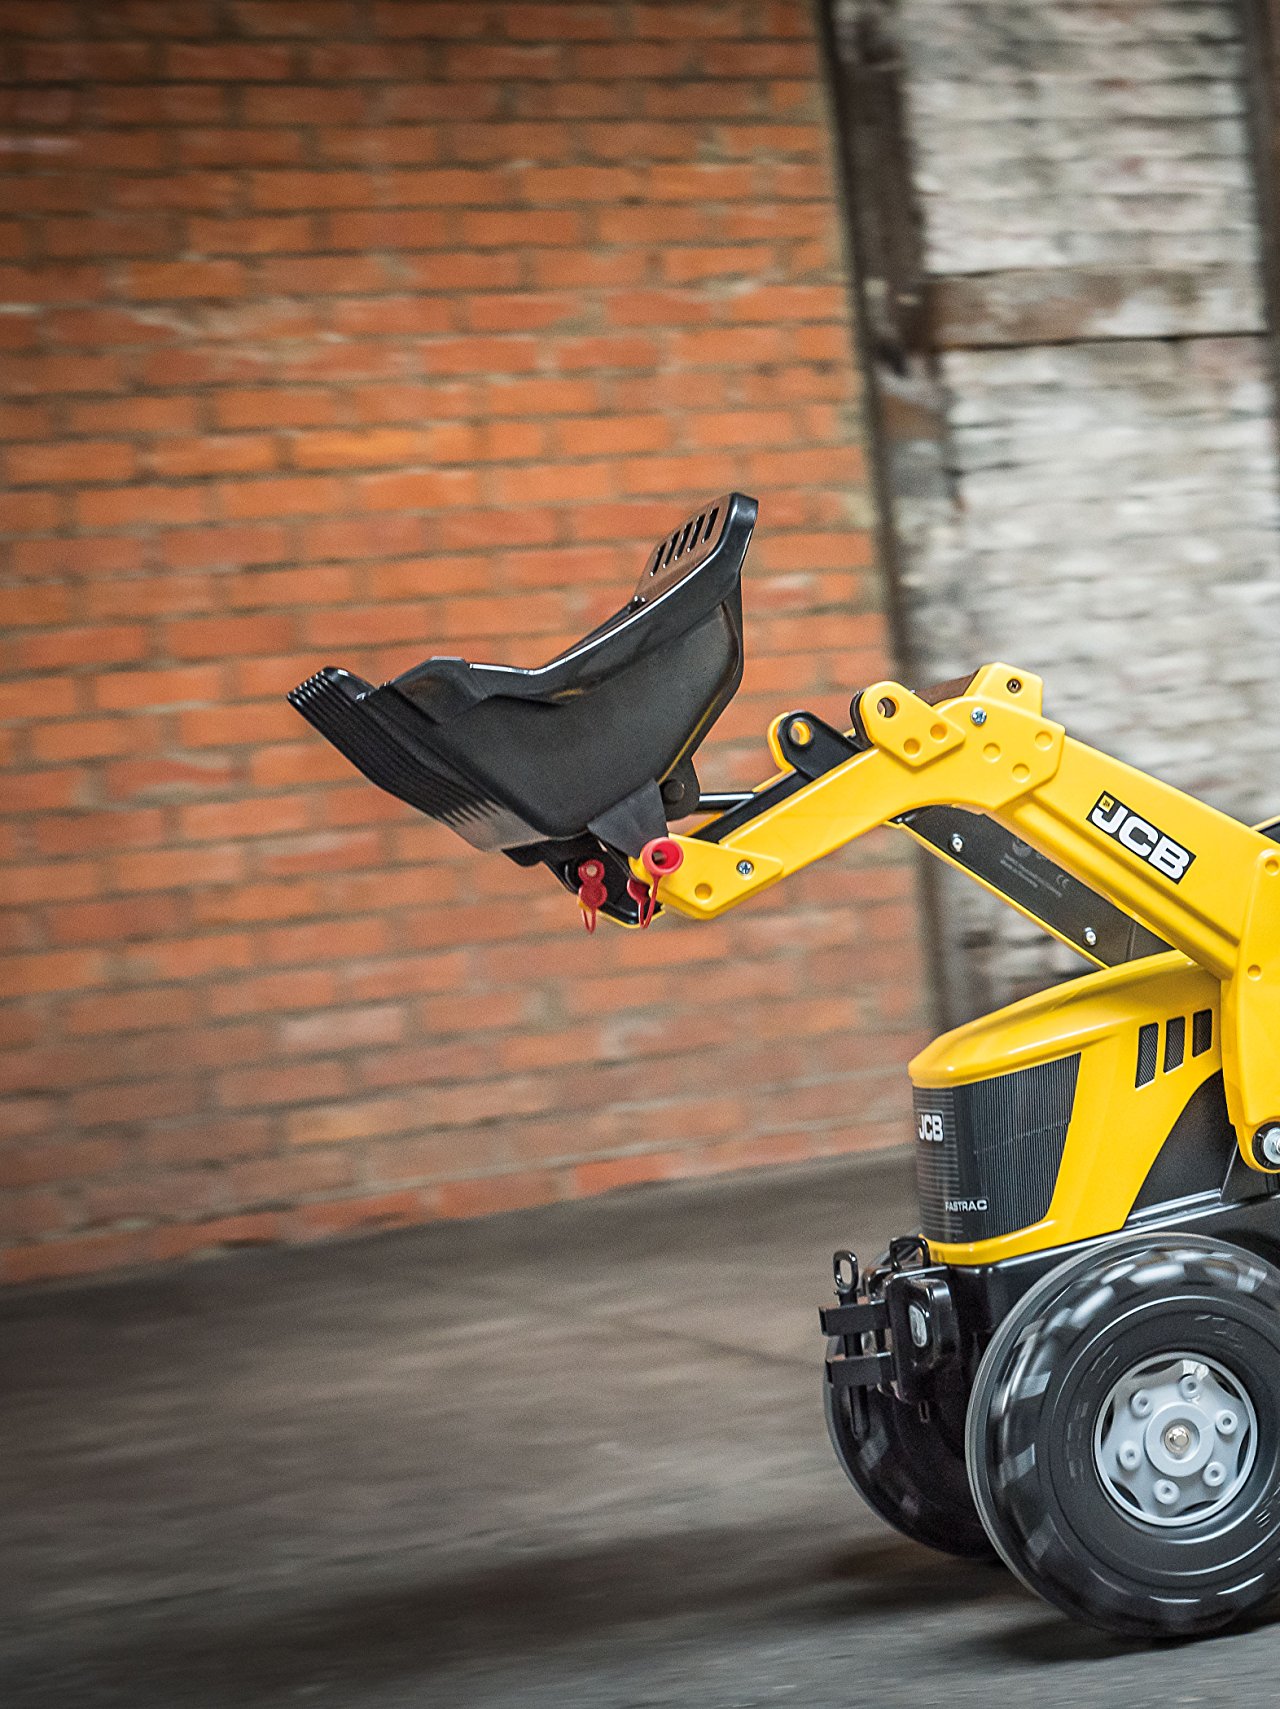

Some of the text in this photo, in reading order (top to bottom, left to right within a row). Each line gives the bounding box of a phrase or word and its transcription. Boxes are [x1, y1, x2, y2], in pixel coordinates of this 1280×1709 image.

[1091, 805, 1190, 880] JCB
[918, 1113, 944, 1142] JCB
[944, 1199, 988, 1212] FASTRAC
